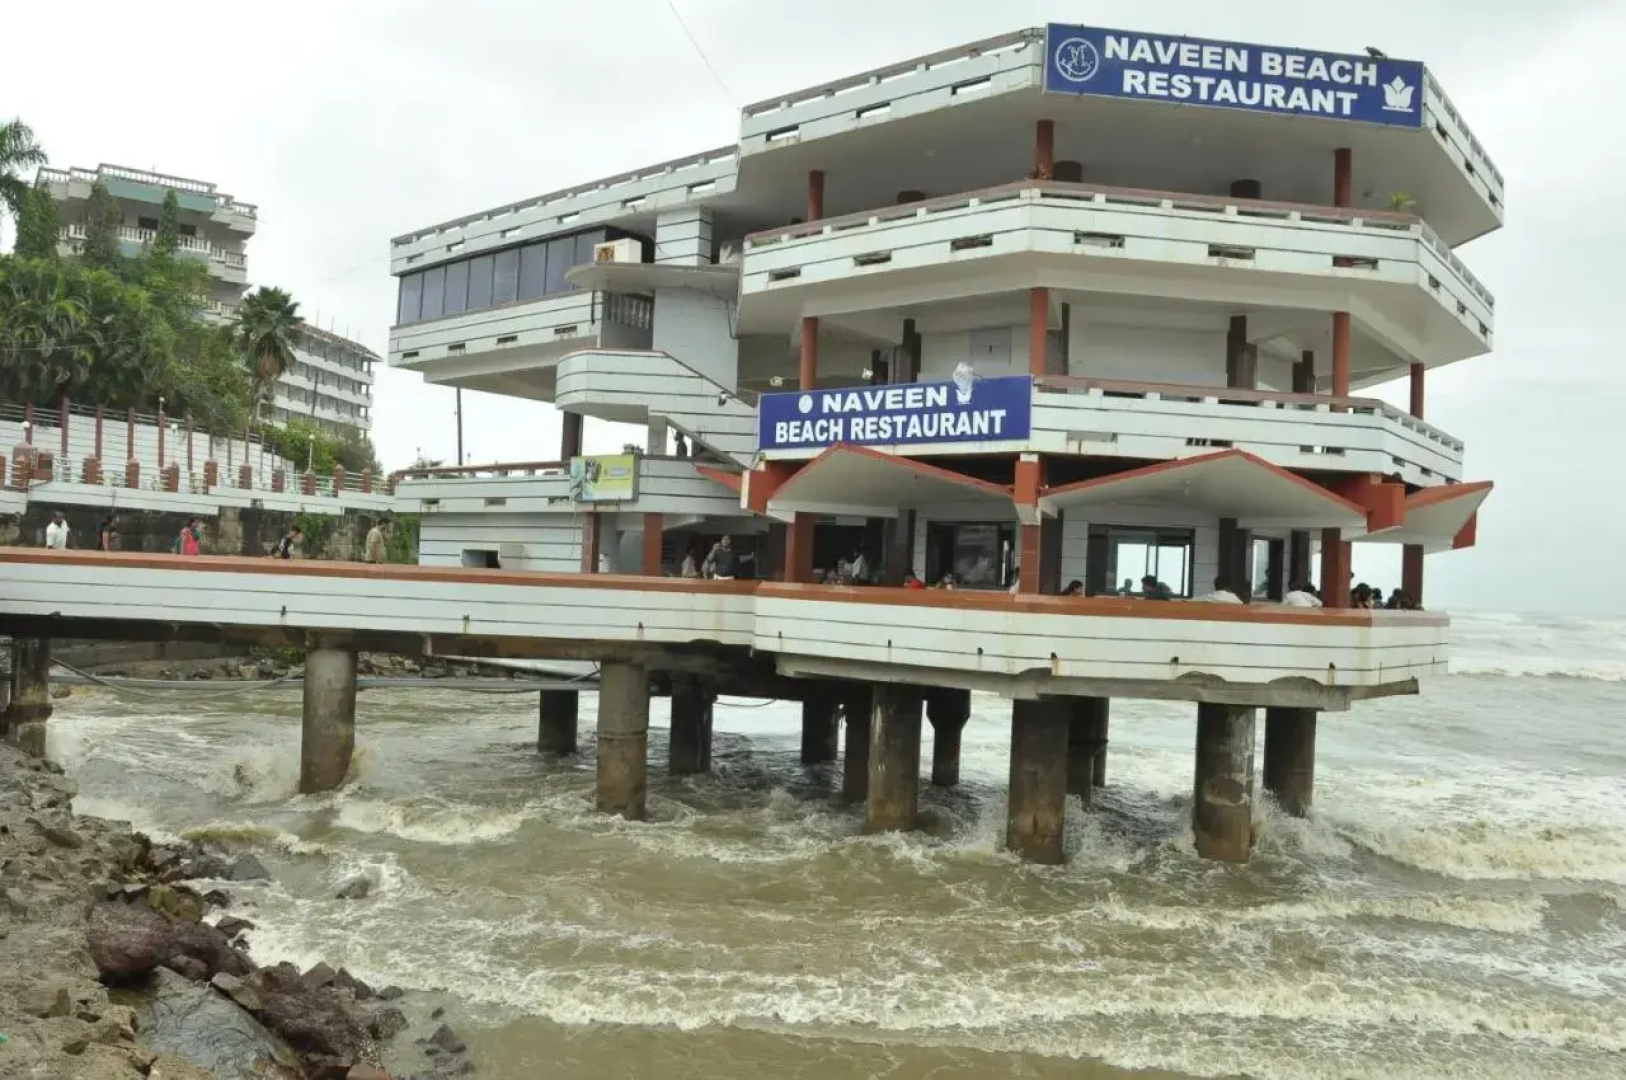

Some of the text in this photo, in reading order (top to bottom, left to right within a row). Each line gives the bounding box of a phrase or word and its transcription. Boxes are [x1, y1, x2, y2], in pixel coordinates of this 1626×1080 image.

[1104, 36, 1248, 72] NAVEEN
[1260, 52, 1378, 86] BEACH
[1122, 69, 1358, 115] RESTAURANT
[822, 386, 947, 413] NAVEEN
[775, 409, 1006, 443] BEACH RESTAURANT
